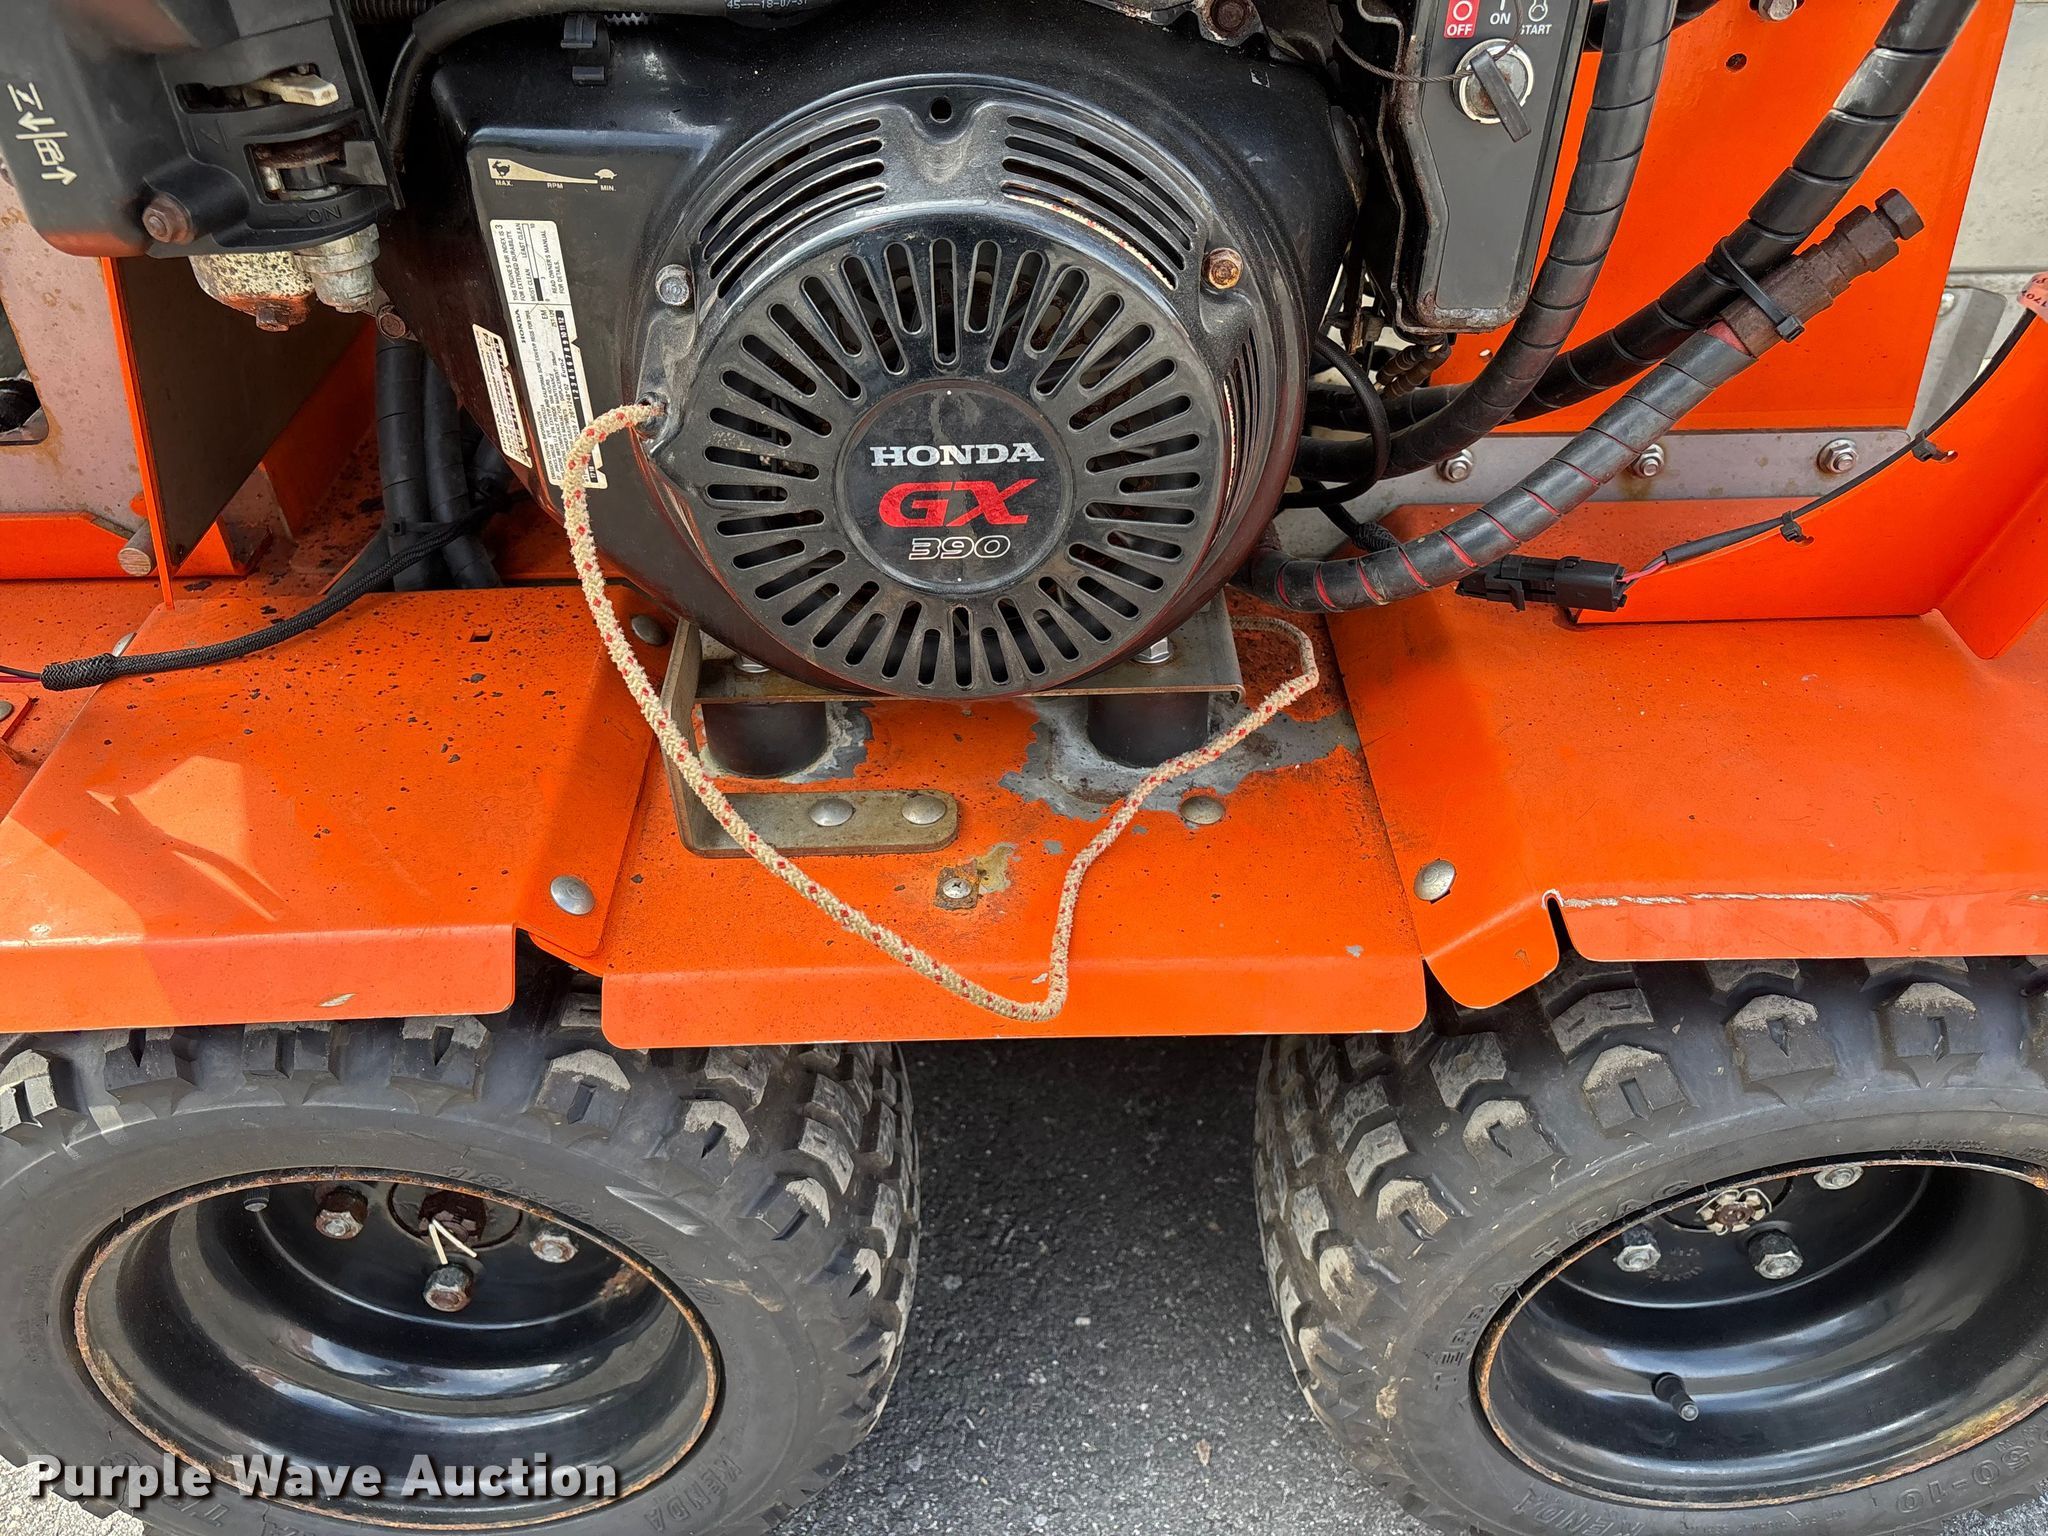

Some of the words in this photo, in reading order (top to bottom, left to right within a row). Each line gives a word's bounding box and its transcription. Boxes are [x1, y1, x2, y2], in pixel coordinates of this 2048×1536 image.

[1490, 13, 1511, 25] ON
[1446, 24, 1473, 36] OFF
[306, 205, 342, 223] ON
[515, 223, 523, 240] CLEAN
[540, 309, 548, 319] EM
[515, 309, 525, 342] HONDA
[870, 443, 1044, 466] HONDA
[879, 479, 1039, 528] GX
[909, 535, 1011, 560] 390
[644, 1454, 742, 1532] KENDA
